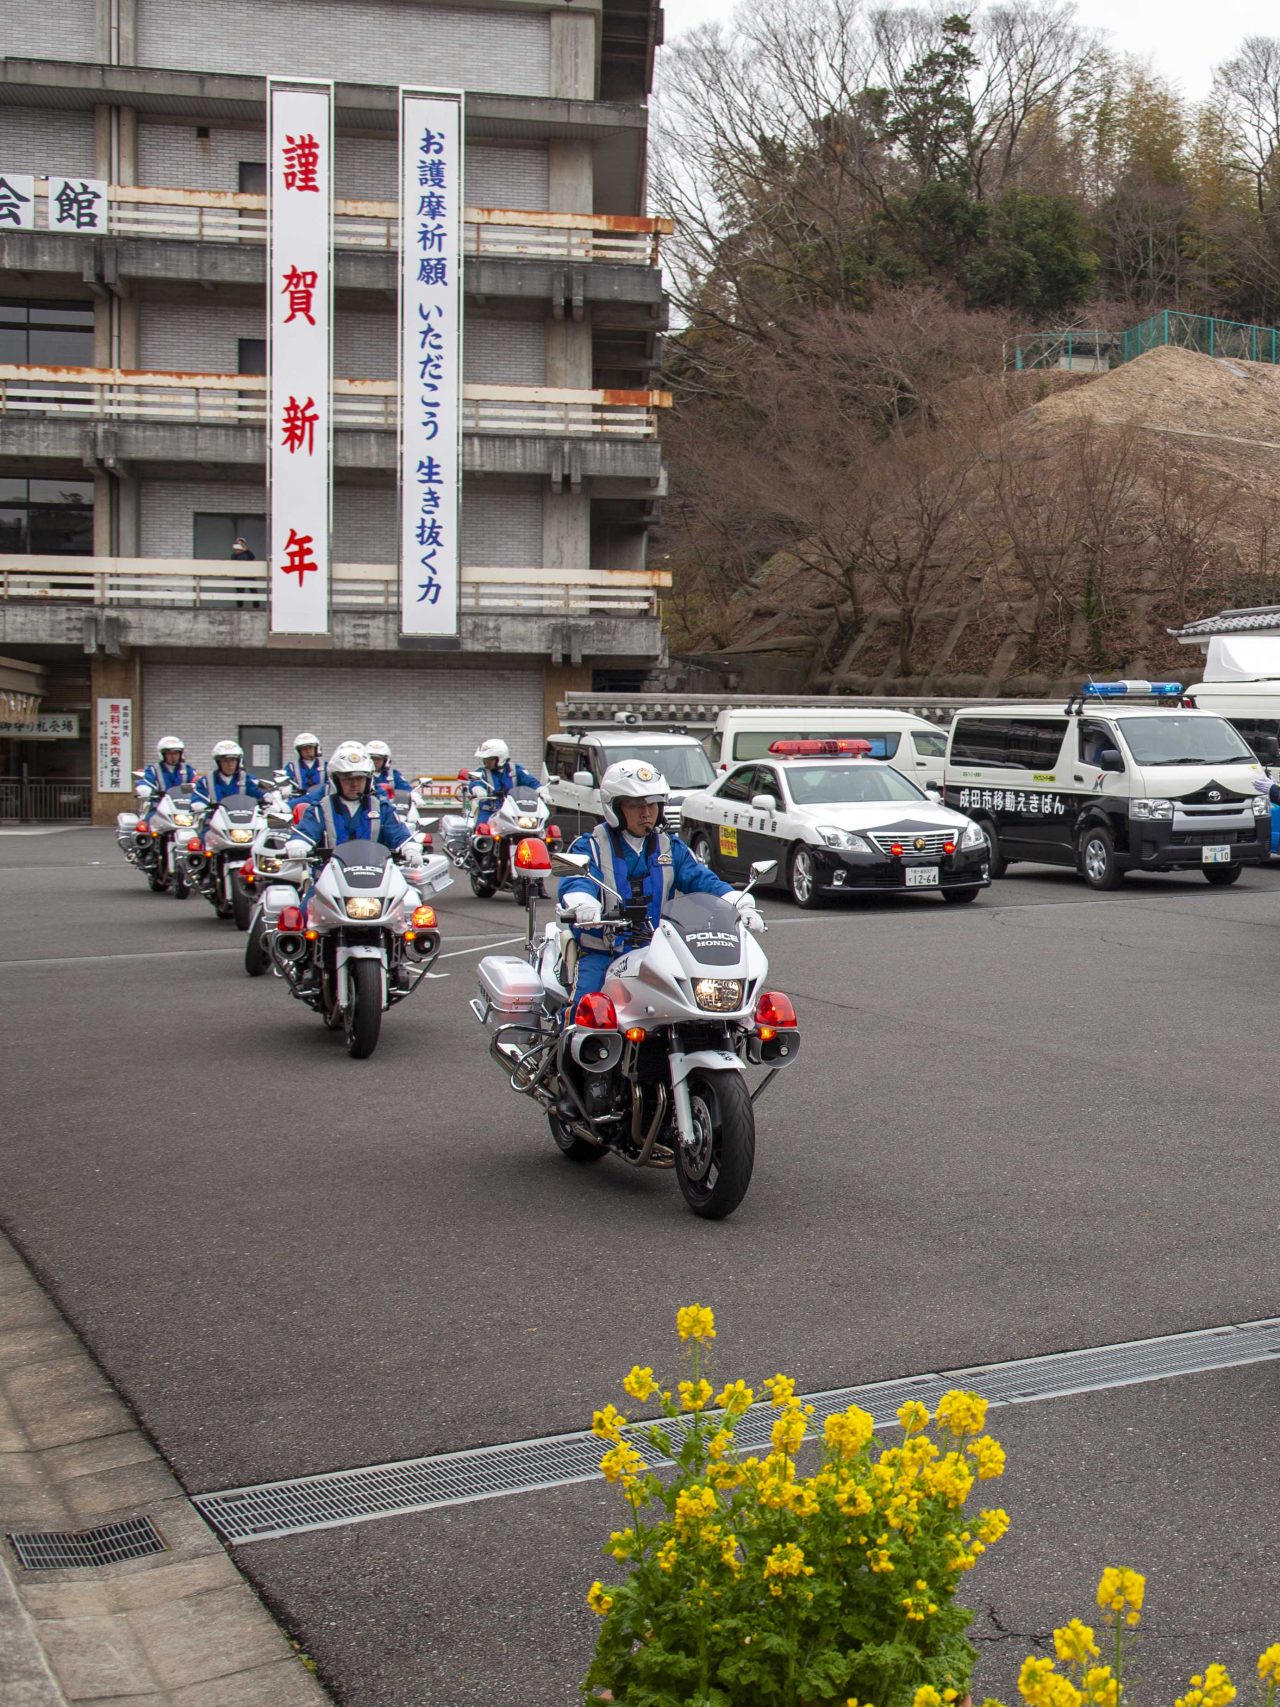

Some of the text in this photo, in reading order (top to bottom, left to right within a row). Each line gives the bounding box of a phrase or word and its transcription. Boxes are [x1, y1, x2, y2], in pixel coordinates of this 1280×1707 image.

[280, 134, 320, 588] 謹賀新年
[416, 127, 448, 606] お護摩祈願 いただこう 生き抜く力
[959, 788, 1065, 815] 成田市移動えきばん
[343, 865, 383, 874] POLICE
[685, 931, 740, 943] POLICE
[695, 940, 736, 948] HONDA
